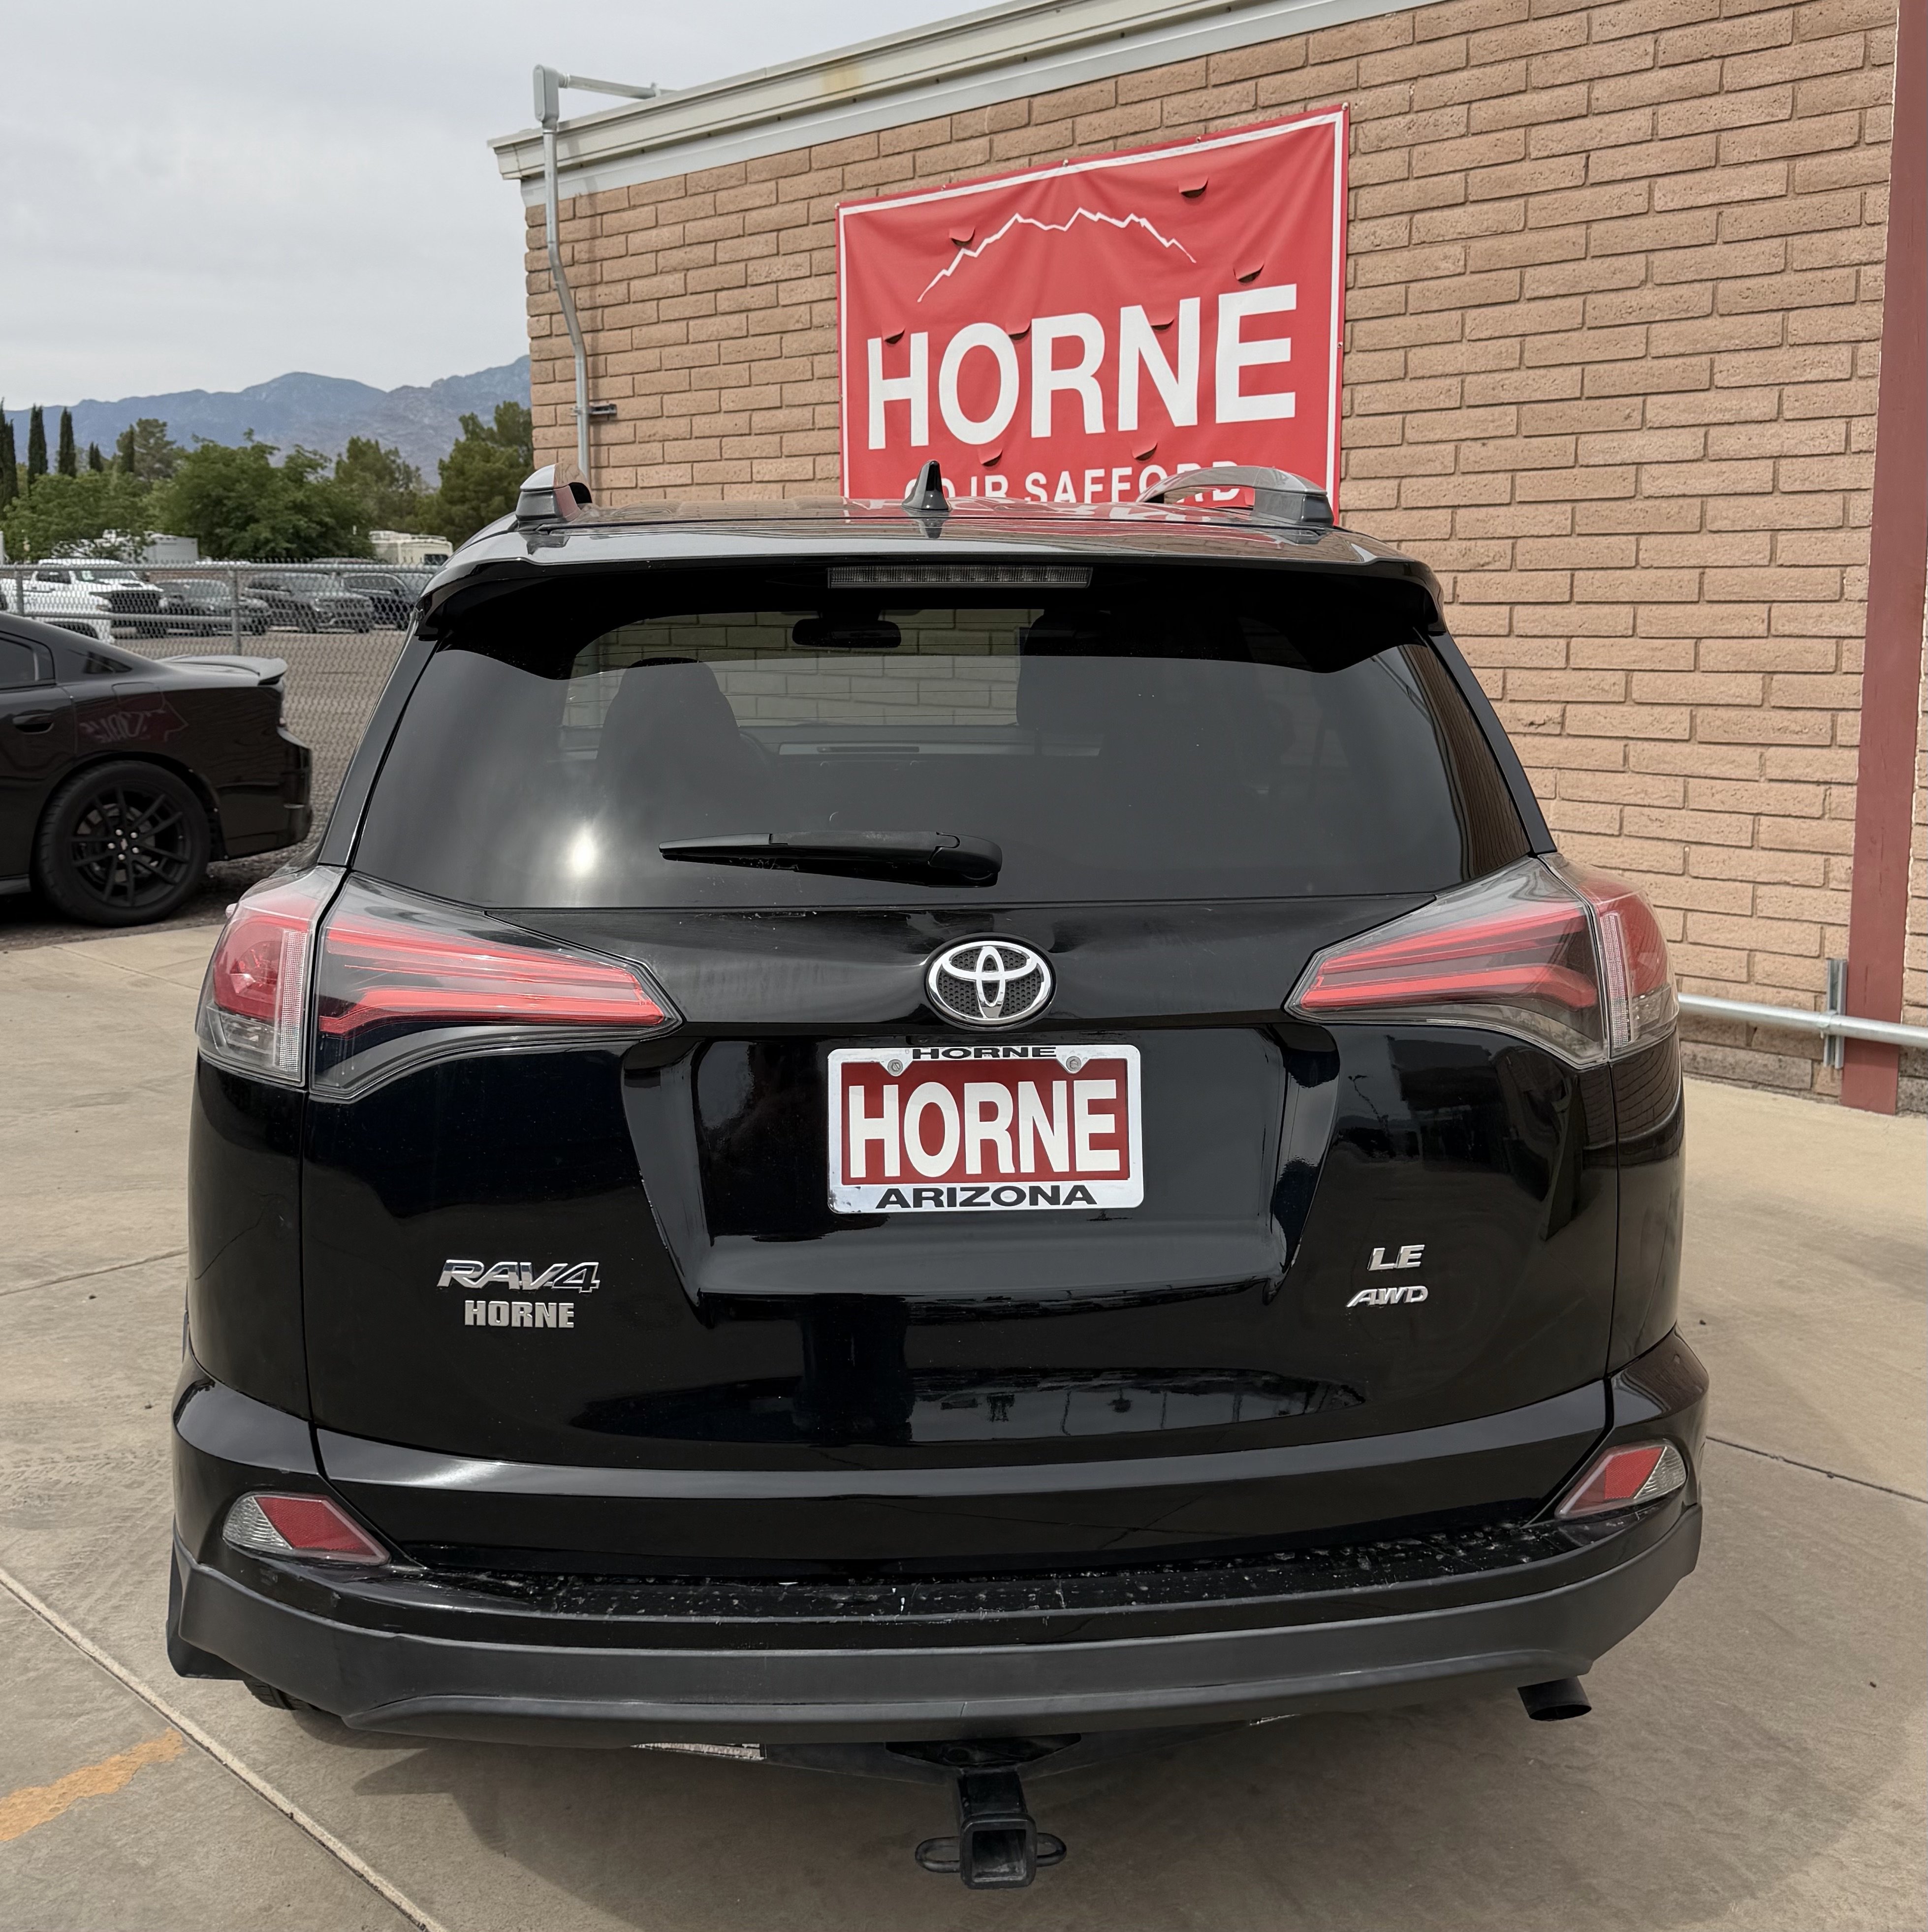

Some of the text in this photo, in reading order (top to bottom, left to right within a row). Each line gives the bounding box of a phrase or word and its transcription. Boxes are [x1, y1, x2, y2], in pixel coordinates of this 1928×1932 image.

[868, 283, 1296, 450] HORNE
[912, 1047, 1056, 1059] HORNE
[849, 1079, 1120, 1178] HORNE
[875, 1185, 1097, 1210] ARIZONA
[1367, 1245, 1425, 1271] LE
[437, 1259, 601, 1293] RAV4
[1346, 1285, 1428, 1307] AWD
[465, 1300, 574, 1328] HORNE
